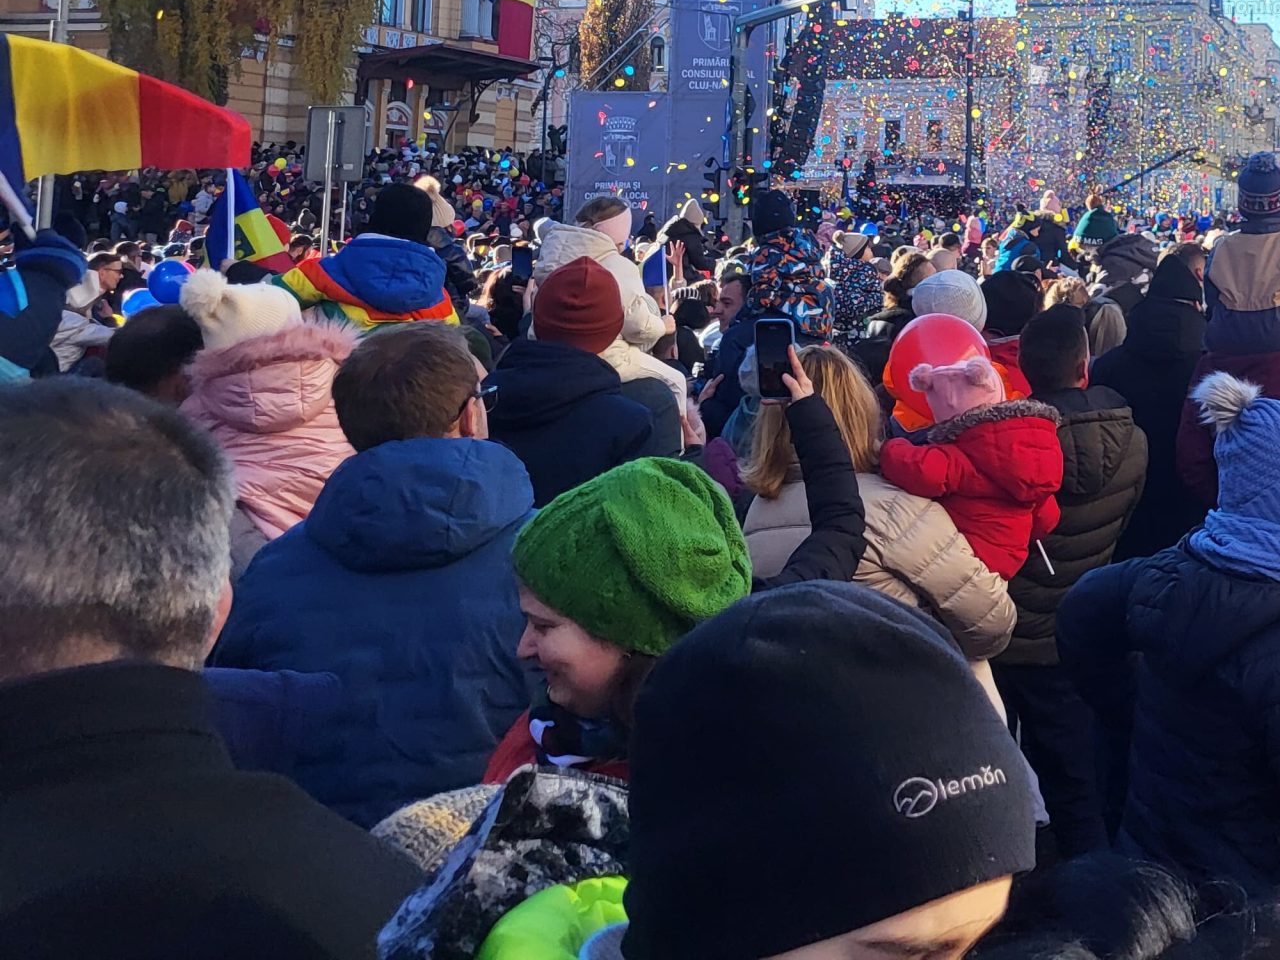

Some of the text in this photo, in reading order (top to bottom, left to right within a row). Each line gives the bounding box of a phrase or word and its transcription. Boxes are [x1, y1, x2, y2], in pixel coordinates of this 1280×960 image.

[693, 57, 730, 67] PRIMĂRI
[682, 69, 727, 79] CONSILIUL
[595, 181, 641, 191] PRIMĂRIA ȘI
[625, 191, 650, 200] LOCAL
